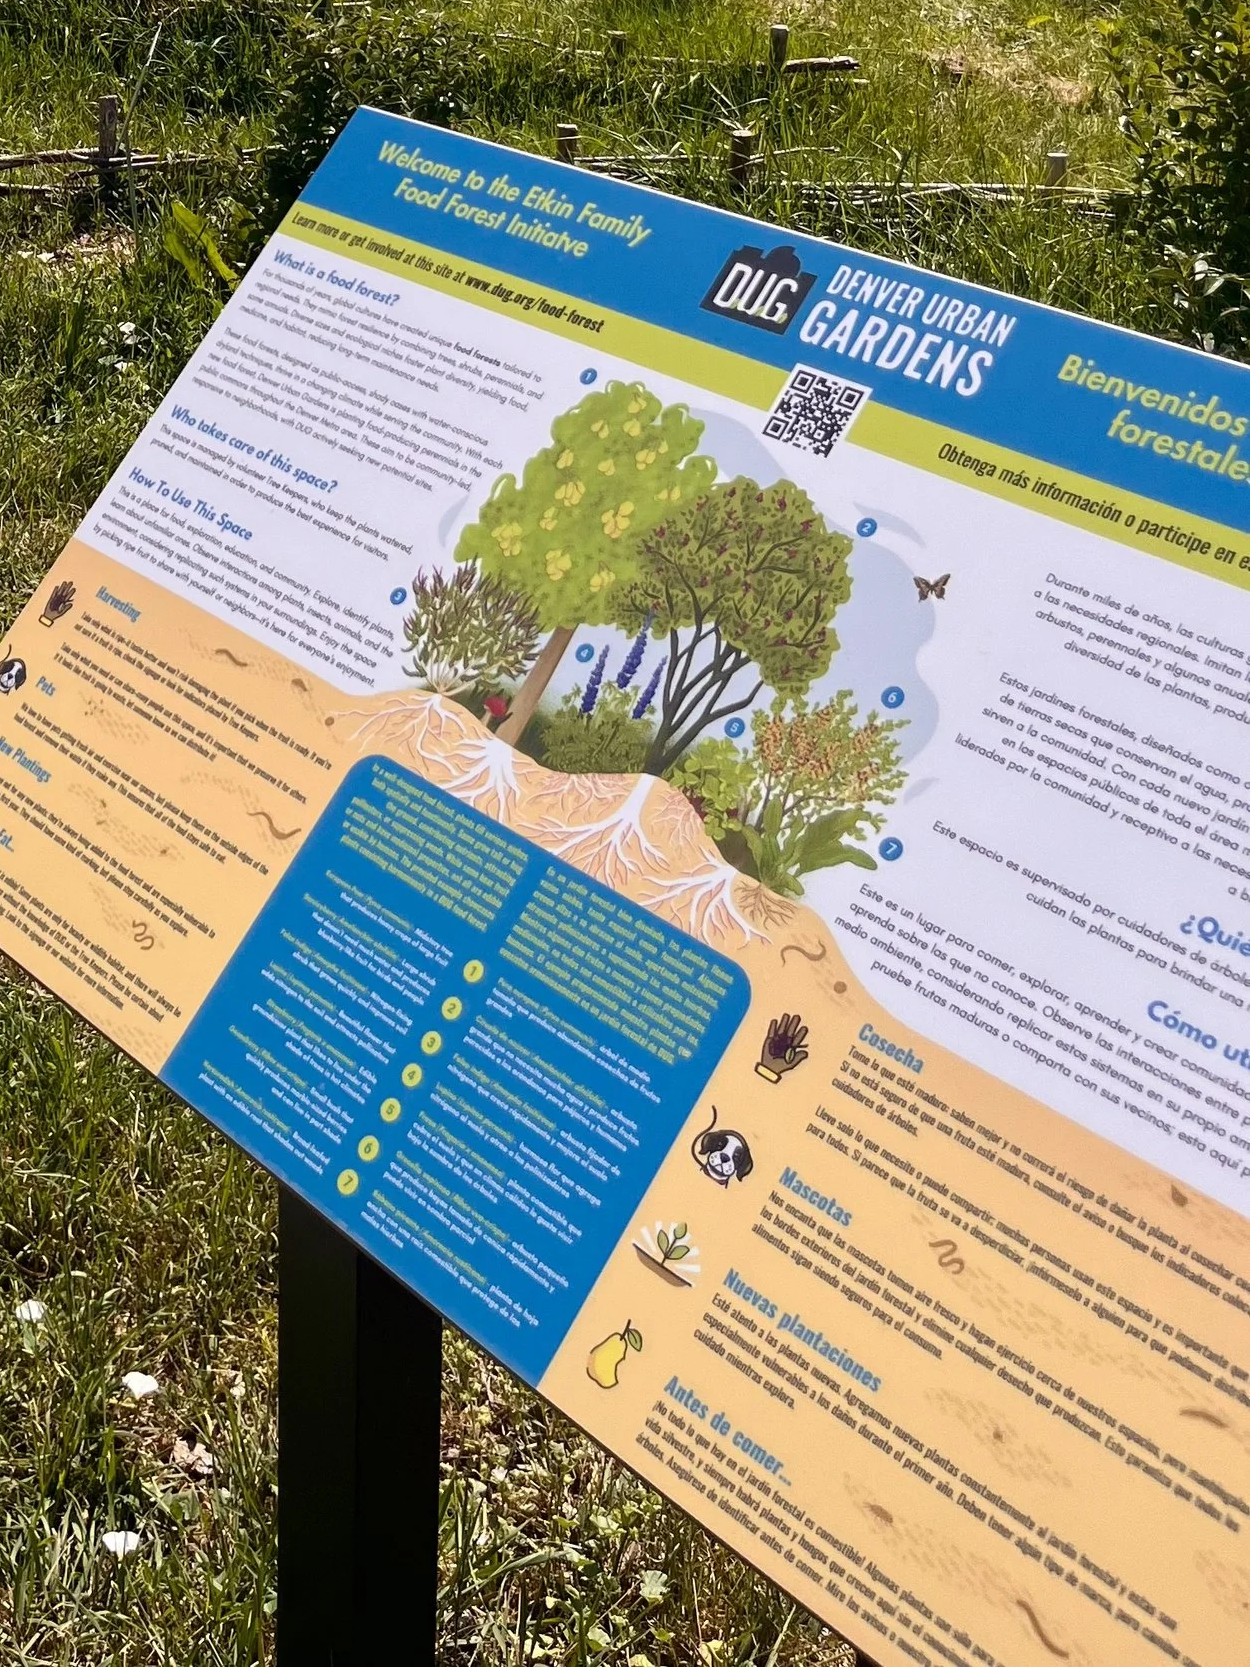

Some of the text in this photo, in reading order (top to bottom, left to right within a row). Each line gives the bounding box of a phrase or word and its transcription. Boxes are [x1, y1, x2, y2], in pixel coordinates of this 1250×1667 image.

[378, 140, 652, 248] Welcome to the Etkin Family
[393, 177, 589, 258] Food Forest Initiatve
[273, 249, 401, 307] What is a food forest?
[291, 211, 605, 334] Learn more or get involved at this site at www.dug.org/food-forest
[712, 262, 799, 322] DUG
[826, 264, 1018, 347] DENVER URBAN
[799, 300, 994, 397] GARDENS
[1057, 353, 1250, 437] Bienvenidos
[171, 404, 339, 494] Who takes care of this space?
[128, 466, 253, 541] How To Use This Space
[938, 443, 998, 478] Obtenga
[997, 468, 1031, 490] más
[1031, 477, 1123, 524] información
[1124, 514, 1137, 528] o
[1135, 519, 1212, 556] participe
[1214, 547, 1237, 565] en
[95, 585, 142, 624] Harvesting
[1033, 590, 1243, 679] a las necesidades regionales. Imitan
[1045, 572, 1246, 660] Durante miles de años, las culturas
[35, 675, 56, 697] Pets
[11, 747, 52, 784] Plantings
[981, 708, 1015, 727] sirven
[1016, 723, 1026, 732] a
[1026, 724, 1039, 738] la
[1040, 734, 1108, 770] comunidad.
[1111, 763, 1137, 783] Con
[1139, 779, 1172, 799] cada
[1173, 794, 1212, 816] nuevo
[999, 672, 1241, 785] Estos jardines forestales, diseñados como
[932, 820, 957, 840] Este
[958, 836, 1004, 864] espacio
[1005, 860, 1020, 872] es
[1021, 868, 1092, 908] supervisado
[1091, 904, 1116, 919] por
[1117, 916, 1188, 956] cuidadores
[1189, 950, 1208, 966] de
[859, 883, 884, 903] Este
[885, 900, 899, 912] es
[900, 908, 915, 921] un
[915, 912, 947, 937] lugar
[945, 933, 975, 953] para
[976, 949, 1016, 977] comer,
[1019, 972, 1070, 1007] explorar,
[1073, 1002, 1133, 1037] aprender
[1131, 1033, 1143, 1044] y
[1143, 1039, 1180, 1062] crear
[858, 1023, 924, 1075] Cosecha
[1147, 1000, 1218, 1050] Cómo
[831, 1078, 919, 1138] cuidadores de árboles.
[778, 1167, 853, 1227] Mascotas
[722, 1268, 882, 1393] Nuevas plantaciones
[751, 1223, 943, 1361] alimentos sigan siendo seguros para el consumo.
[663, 1375, 709, 1420] Antes
[709, 1412, 731, 1437] de
[693, 1329, 795, 1411] cuidado mientras explora.
